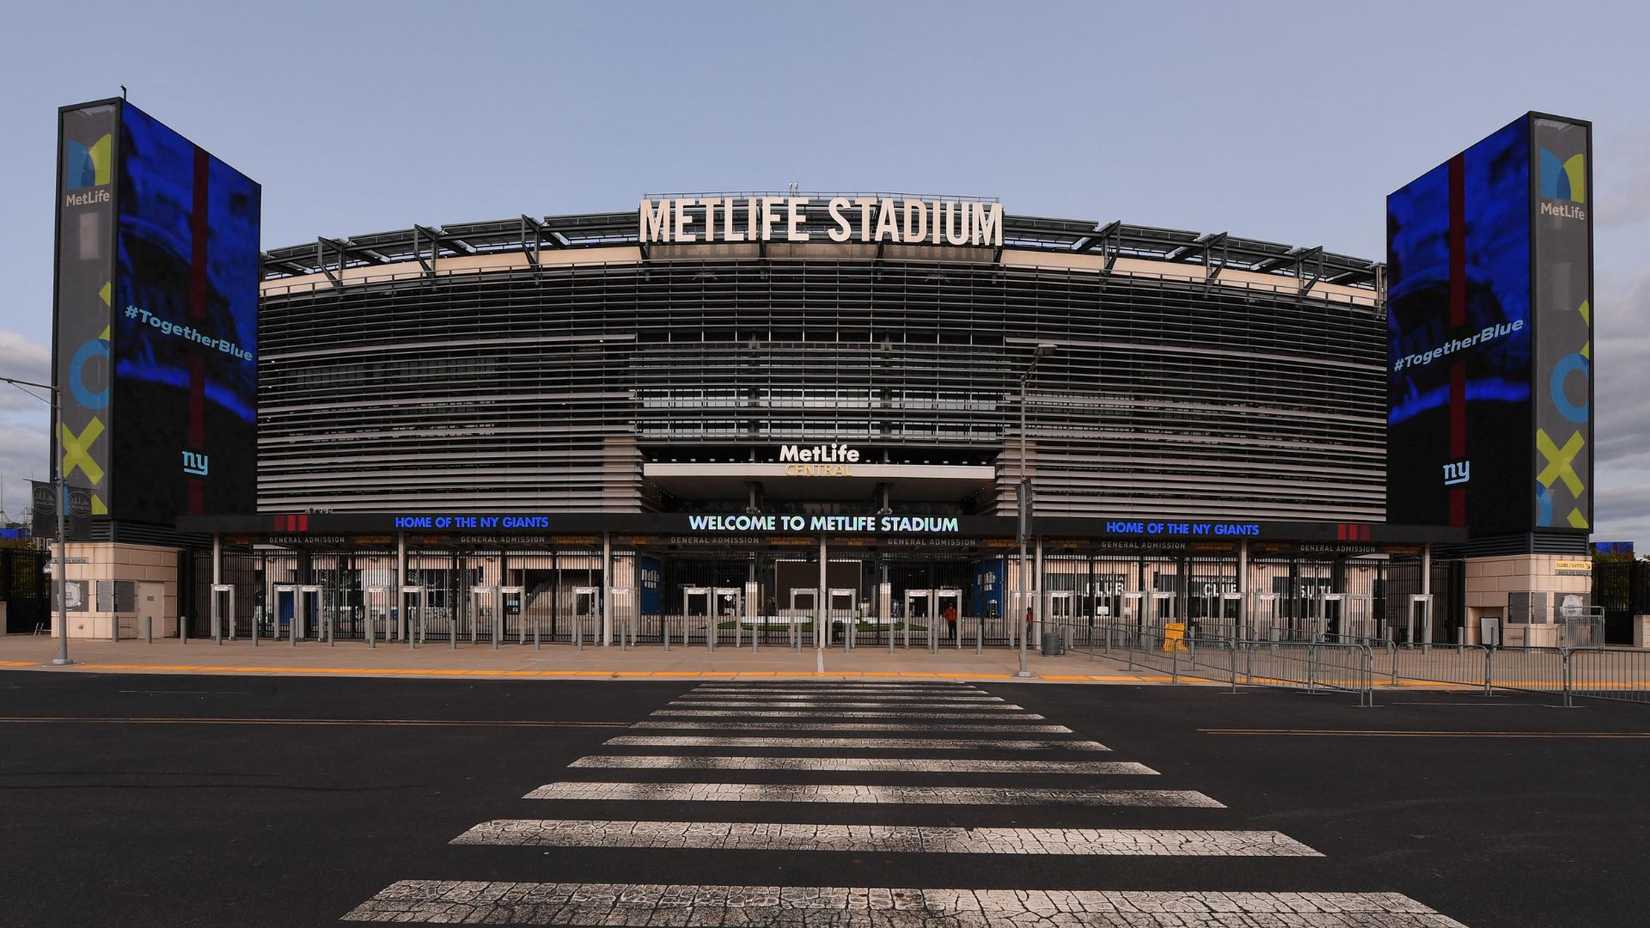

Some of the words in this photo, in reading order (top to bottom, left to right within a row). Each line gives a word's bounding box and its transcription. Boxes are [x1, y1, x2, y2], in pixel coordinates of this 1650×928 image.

[65, 189, 111, 207] MetLife
[1540, 202, 1585, 220] MetLife
[639, 197, 810, 243] METLIFE
[828, 197, 1003, 247] STADIUM
[124, 303, 254, 361] #TogetherBlue
[1393, 318, 1524, 373] #TogetherBlue
[780, 443, 860, 462] MetLife
[395, 516, 433, 528] HOME
[435, 516, 452, 528] OF
[454, 516, 477, 528] THE
[480, 516, 499, 528] NY
[502, 516, 549, 528] GIANTS
[688, 515, 776, 531] WELCOME
[781, 515, 806, 531] TO
[810, 516, 876, 532] METLIFE
[881, 516, 959, 533] STADIUM
[1106, 521, 1144, 533] HOME
[1147, 522, 1165, 534] OF
[1167, 523, 1190, 535] THE
[1193, 523, 1211, 535] NY
[1214, 524, 1260, 536] GIANTS
